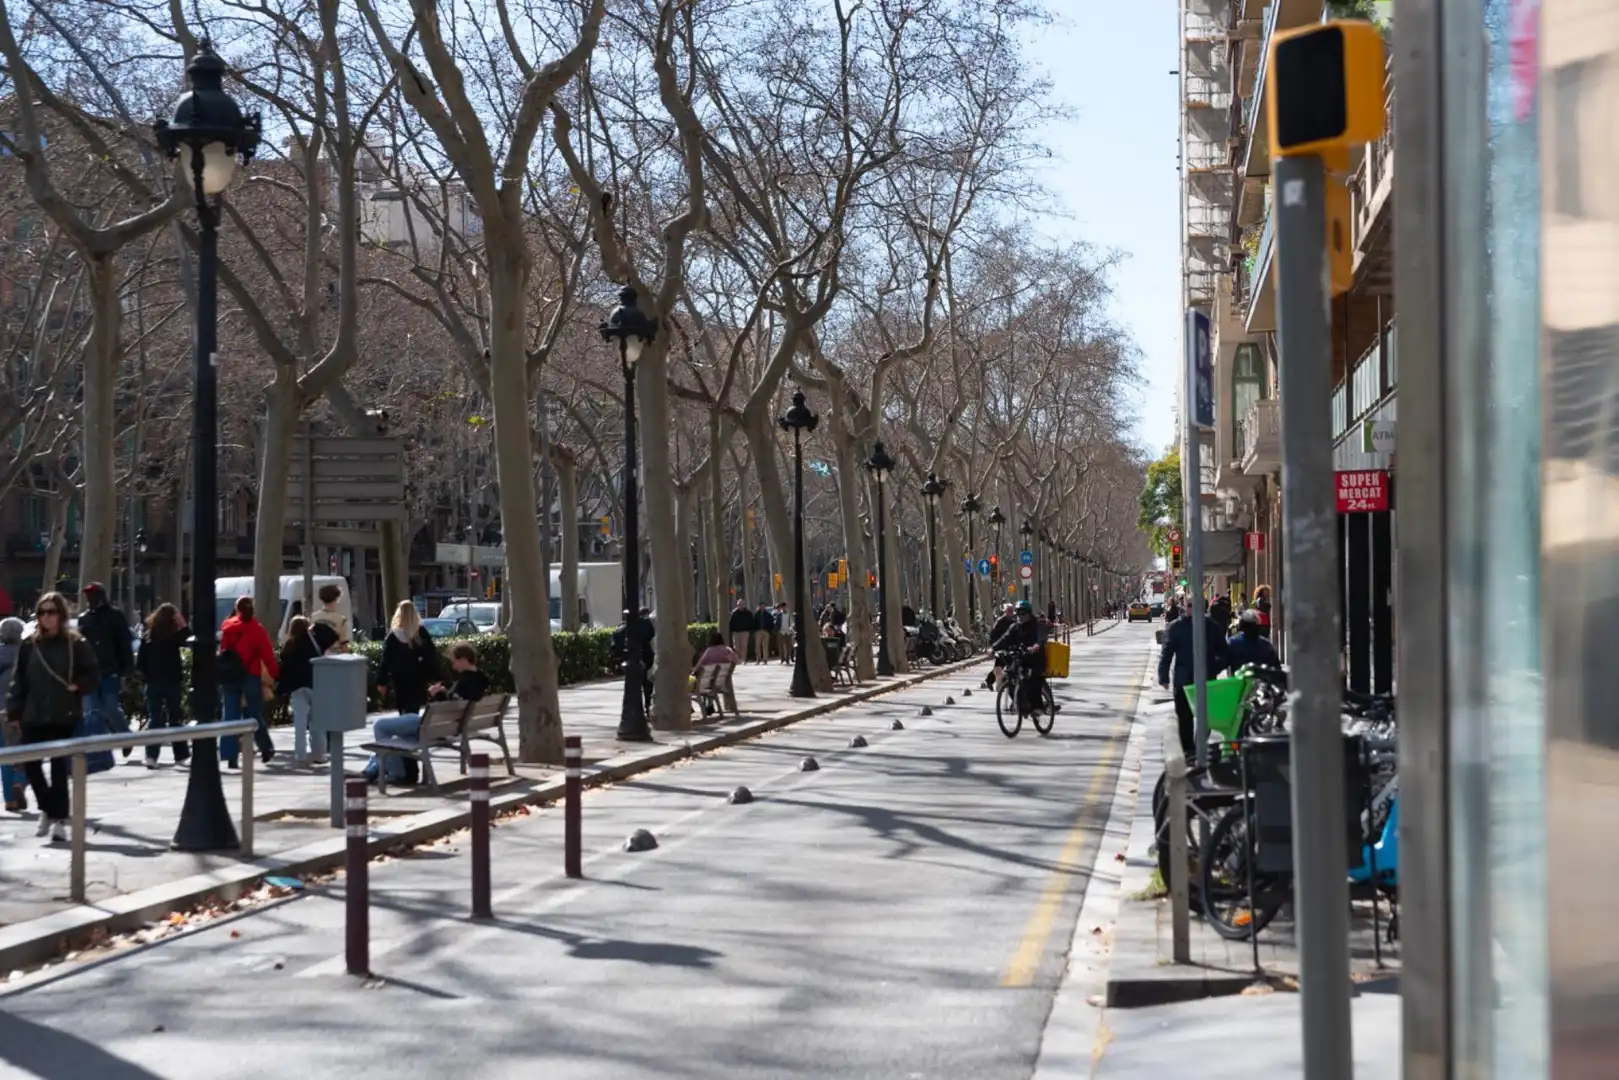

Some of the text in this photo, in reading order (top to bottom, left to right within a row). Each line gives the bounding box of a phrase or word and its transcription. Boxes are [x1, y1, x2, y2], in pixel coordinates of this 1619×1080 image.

[1372, 430, 1395, 441] ATM
[1341, 471, 1380, 487] SUPER
[1339, 487, 1382, 499] MERCAT
